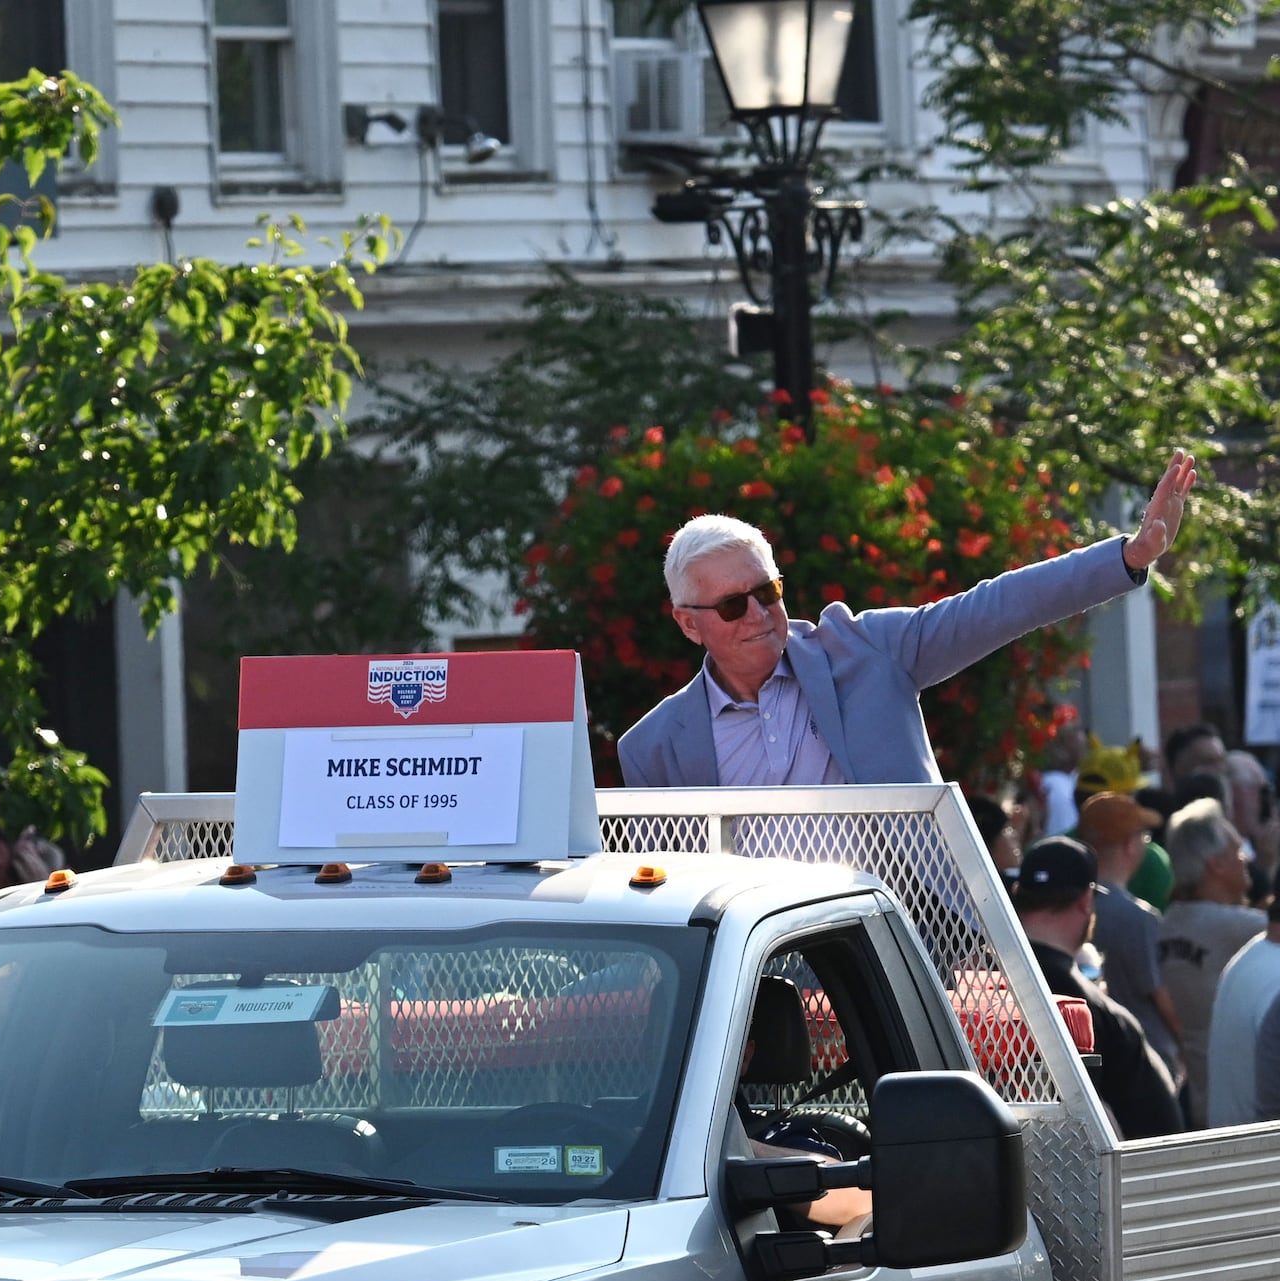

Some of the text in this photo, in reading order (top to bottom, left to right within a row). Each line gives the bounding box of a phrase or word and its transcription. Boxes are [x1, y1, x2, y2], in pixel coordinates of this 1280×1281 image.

[369, 670, 446, 682] INDUCTION
[327, 757, 482, 777] MIKE SCHMIDT
[346, 794, 458, 809] CLASS OF 1995
[234, 1001, 294, 1012] INDUCTION
[541, 1158, 557, 1166] 28
